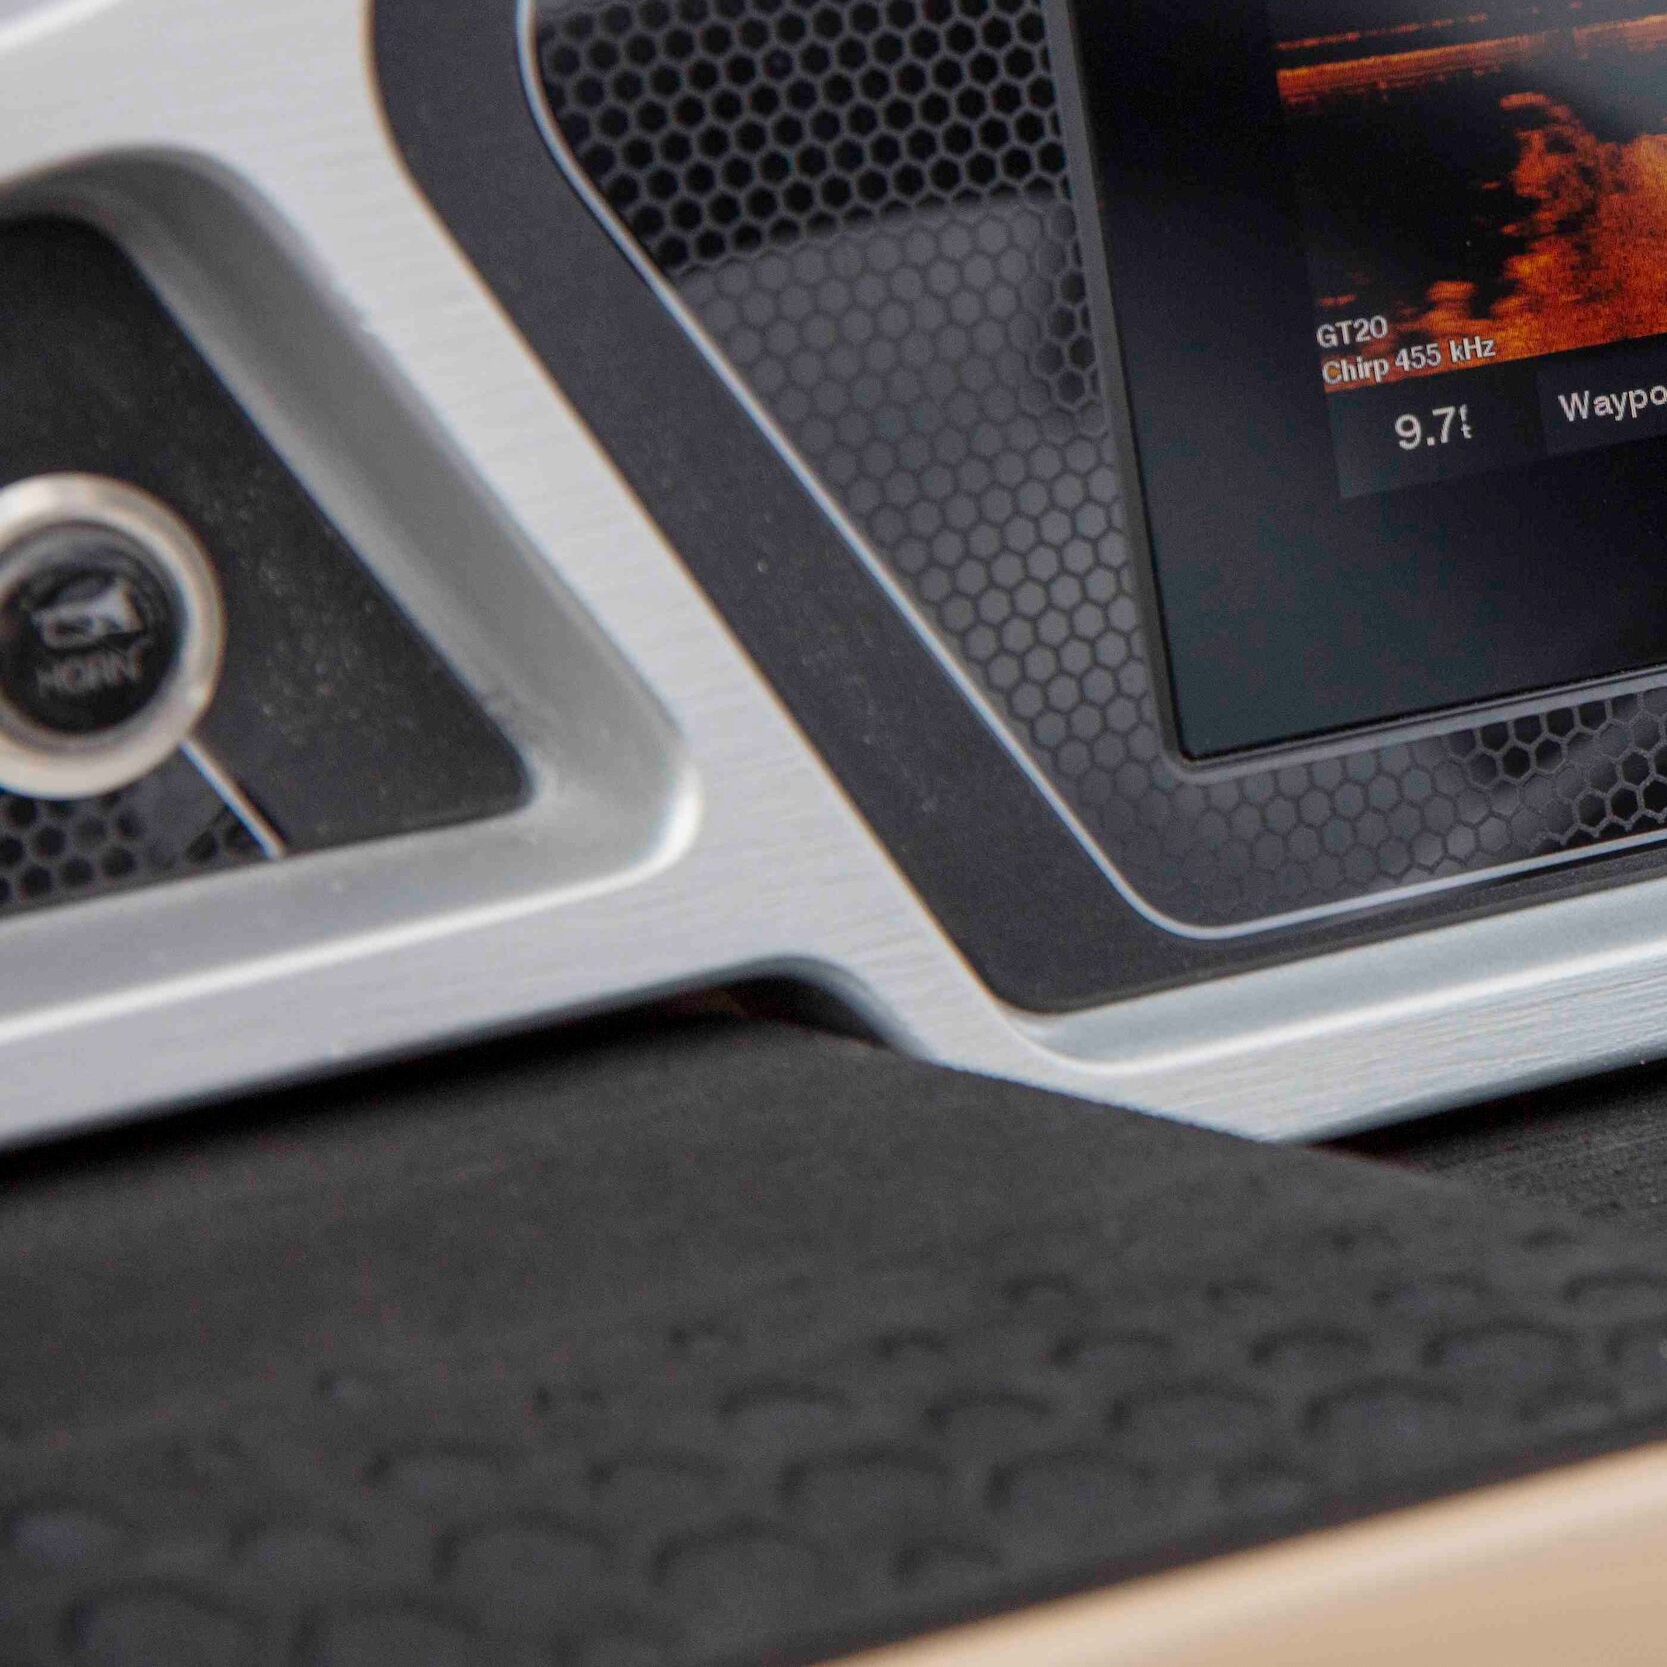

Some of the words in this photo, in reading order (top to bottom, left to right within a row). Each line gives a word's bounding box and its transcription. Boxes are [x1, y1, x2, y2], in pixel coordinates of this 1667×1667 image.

[1316, 315, 1389, 349] GT20
[1322, 355, 1389, 384] Chirp
[1395, 343, 1442, 372] 455
[1449, 335, 1496, 363] kHz
[1394, 405, 1456, 451] 9.7
